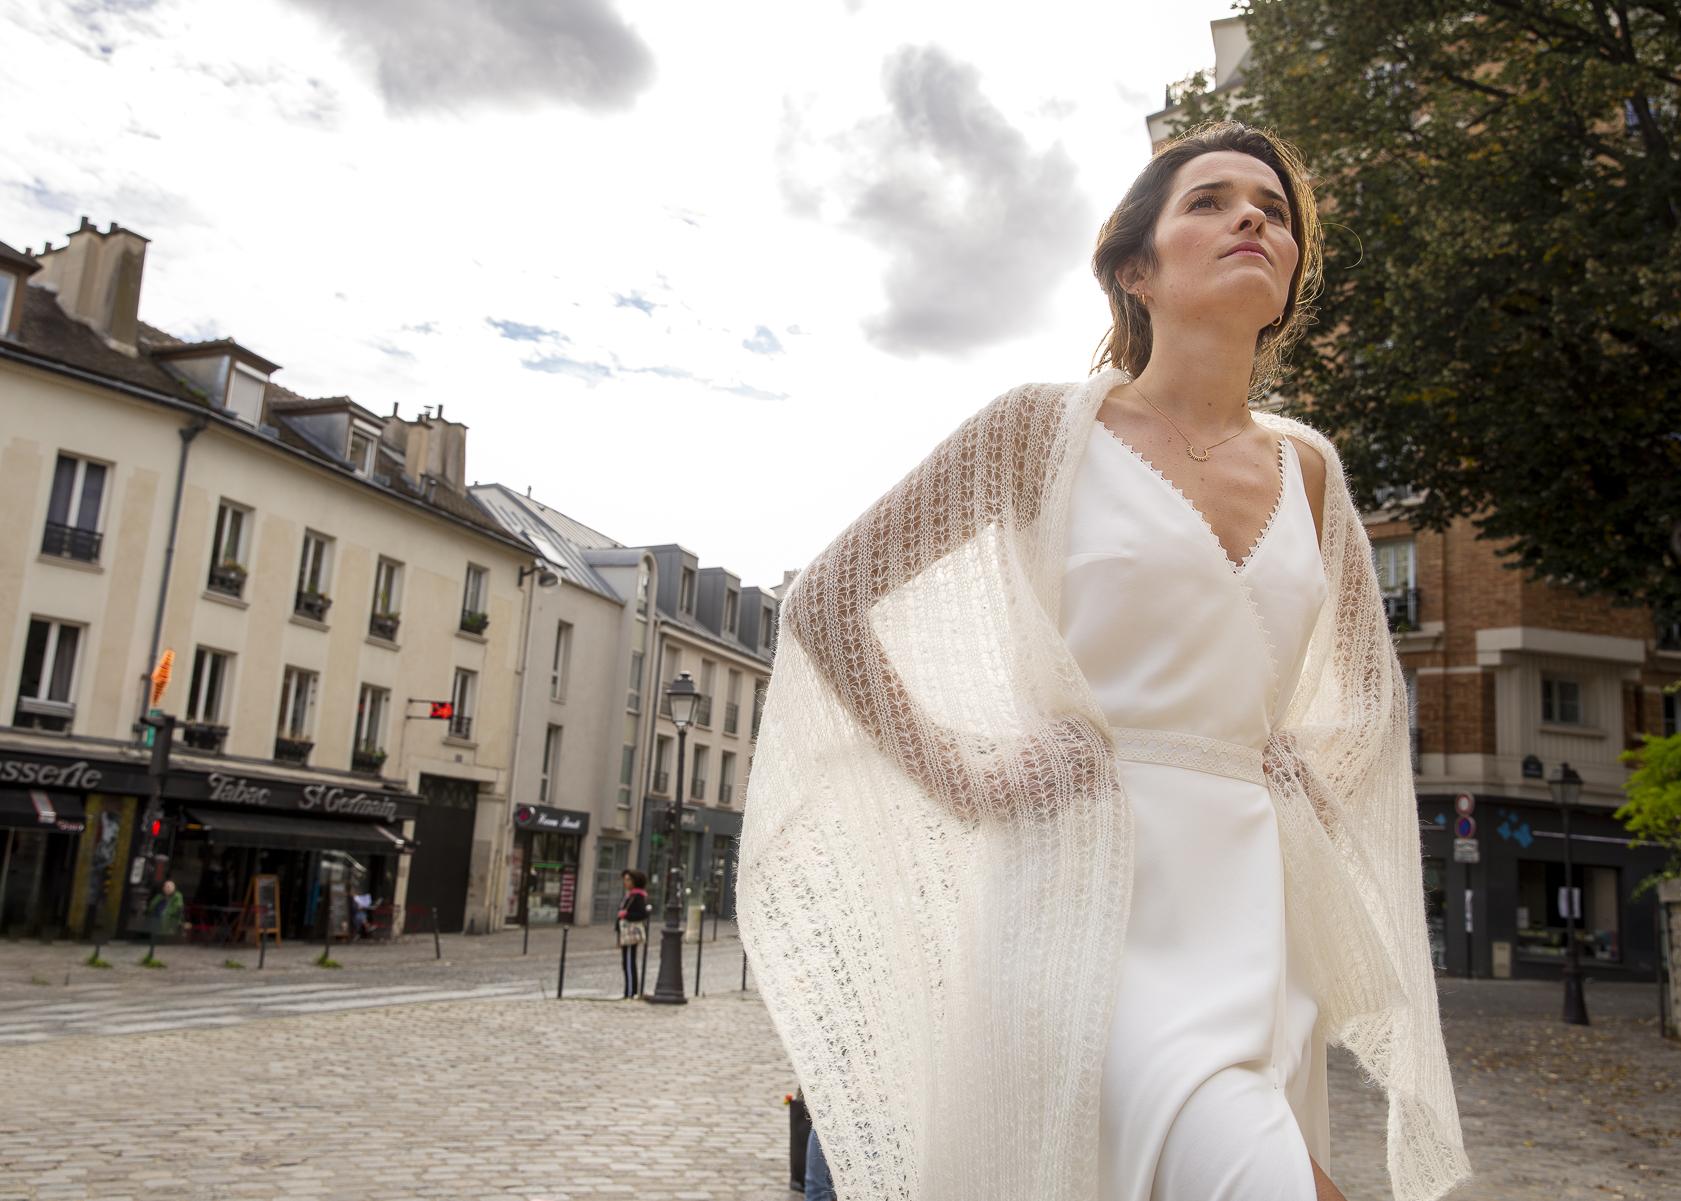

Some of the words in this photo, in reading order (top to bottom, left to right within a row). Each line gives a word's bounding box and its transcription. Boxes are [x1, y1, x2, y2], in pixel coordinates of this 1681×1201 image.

[0, 761, 102, 789] sserie
[208, 773, 271, 805] Tabac
[299, 785, 326, 809] St
[325, 788, 397, 823] Germain
